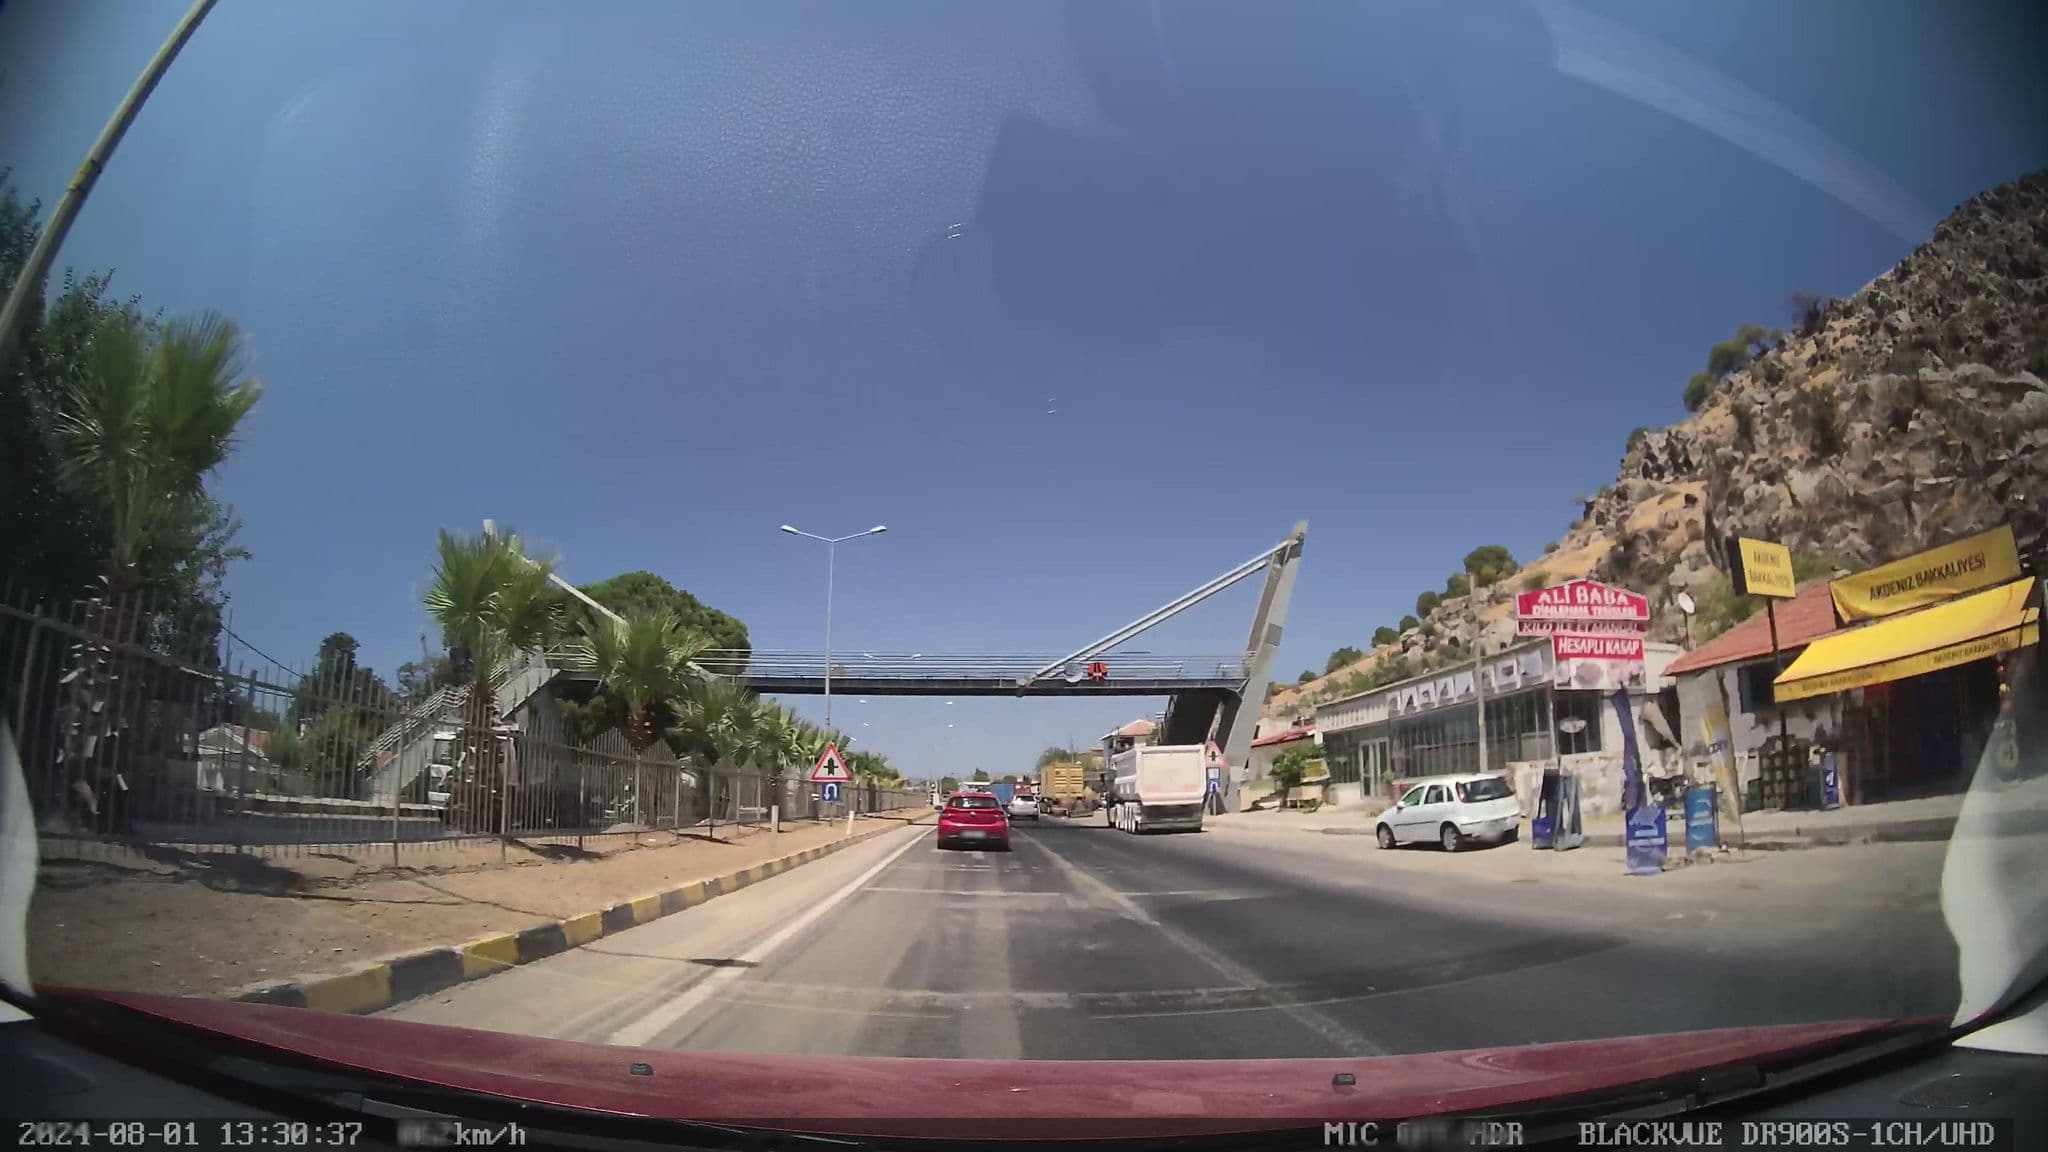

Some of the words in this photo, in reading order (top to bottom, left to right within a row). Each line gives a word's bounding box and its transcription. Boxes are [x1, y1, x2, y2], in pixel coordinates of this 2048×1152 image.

[1575, 586, 1629, 605] BABA
[1558, 637, 1604, 655] HESAPLI
[1605, 639, 1640, 656] KASAP
